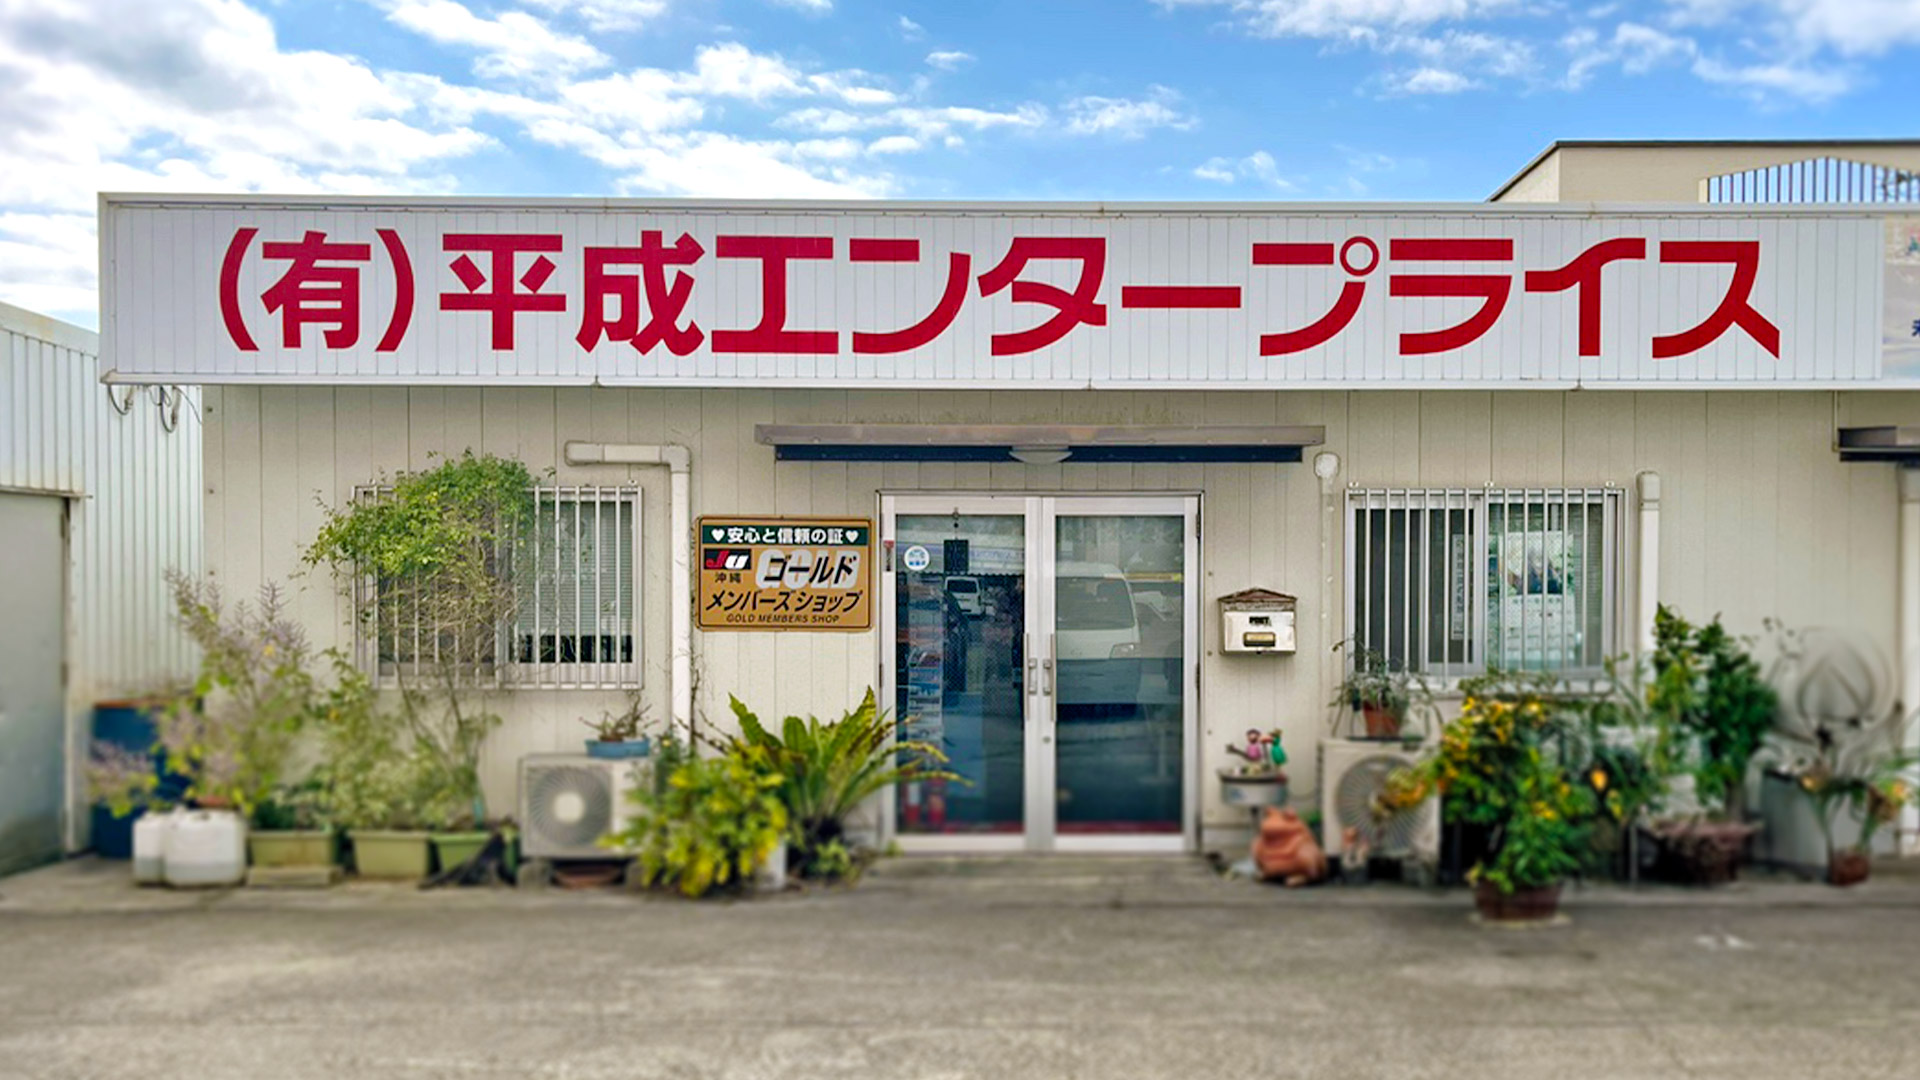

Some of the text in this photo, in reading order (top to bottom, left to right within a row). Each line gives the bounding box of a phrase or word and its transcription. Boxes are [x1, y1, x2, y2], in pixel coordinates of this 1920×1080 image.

[219, 228, 1780, 359] (有)平成エンタープライス
[727, 528, 844, 544] 安心と信頼の証
[763, 555, 857, 585] ゴールド
[706, 589, 863, 612] メンバーズショップ
[726, 613, 840, 624] GOLD MEMBERS SHOP
